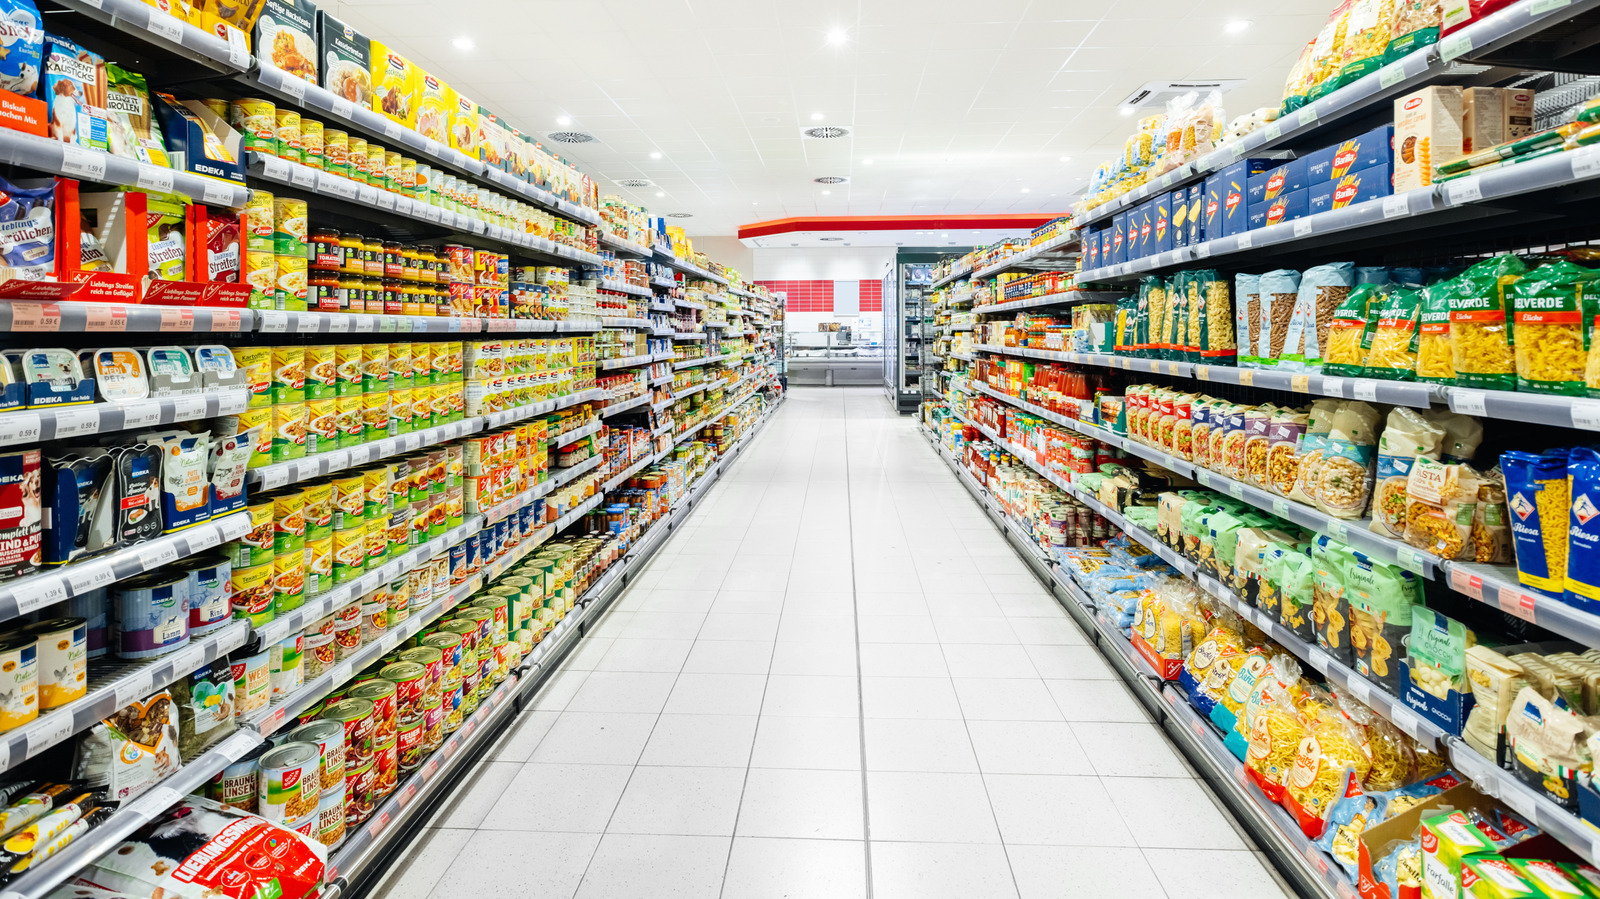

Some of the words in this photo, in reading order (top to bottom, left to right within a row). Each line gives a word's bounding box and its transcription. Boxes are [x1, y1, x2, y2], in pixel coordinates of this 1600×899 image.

[45, 36, 76, 51] EDEKA
[61, 57, 94, 73] PRODENT
[46, 62, 95, 82] KAUSTICKS
[2, 101, 26, 114] Biskuit
[1404, 99, 1423, 110] Barilla
[0, 111, 23, 122] nochen
[24, 113, 37, 125] Mix
[1335, 151, 1358, 167] Barilla
[87, 164, 98, 172] 1.59
[195, 164, 225, 177] EDEKA
[1310, 162, 1330, 172] SPAGHETTI
[1268, 178, 1285, 189] Barilla
[1336, 186, 1358, 200] Barilla
[1226, 196, 1242, 206] Barilla
[1312, 194, 1330, 204] SPAGHETTI
[1207, 204, 1218, 214] Barilla
[1268, 208, 1285, 218] Barilla
[80, 246, 104, 264] eifen
[150, 246, 184, 265] Streifen
[209, 258, 239, 274] Streifen
[90, 281, 115, 290] Lieblings
[115, 283, 134, 291] Streifen
[112, 290, 134, 299] Geflügel
[40, 318, 51, 326] 0.59
[1522, 314, 1544, 322] Eliche
[157, 364, 175, 372] MEDI
[203, 361, 220, 369] MEDI
[100, 366, 123, 376] MEDI
[104, 374, 126, 383] PET+
[34, 396, 62, 405] EDEKA
[81, 422, 91, 430] 0.59
[19, 430, 31, 438] 0.59
[132, 470, 150, 478] EDEKA
[187, 470, 198, 478] PUTE
[212, 506, 228, 514] EDEKA
[172, 518, 190, 527] EDEKA
[1514, 522, 1540, 536] Riesa
[1569, 526, 1600, 542] Riesa
[1, 539, 22, 553] IND
[30, 532, 42, 543] PUT
[162, 550, 170, 558] 0.99
[95, 574, 106, 583] 0.99
[198, 578, 218, 587] EDEKA
[45, 590, 56, 599] 1.39
[152, 596, 174, 605] EDEKA
[210, 608, 223, 618] Rind
[162, 628, 181, 641] Lamm
[194, 669, 212, 680] EDEKA
[54, 728, 65, 738] 1.79
[400, 726, 421, 742] FEUER
[224, 774, 256, 788] BRAUNE
[224, 784, 256, 798] LINSEN
[320, 804, 343, 819] BRAUNE
[320, 814, 344, 829] LINSEN
[1426, 864, 1454, 894] Farfalle
